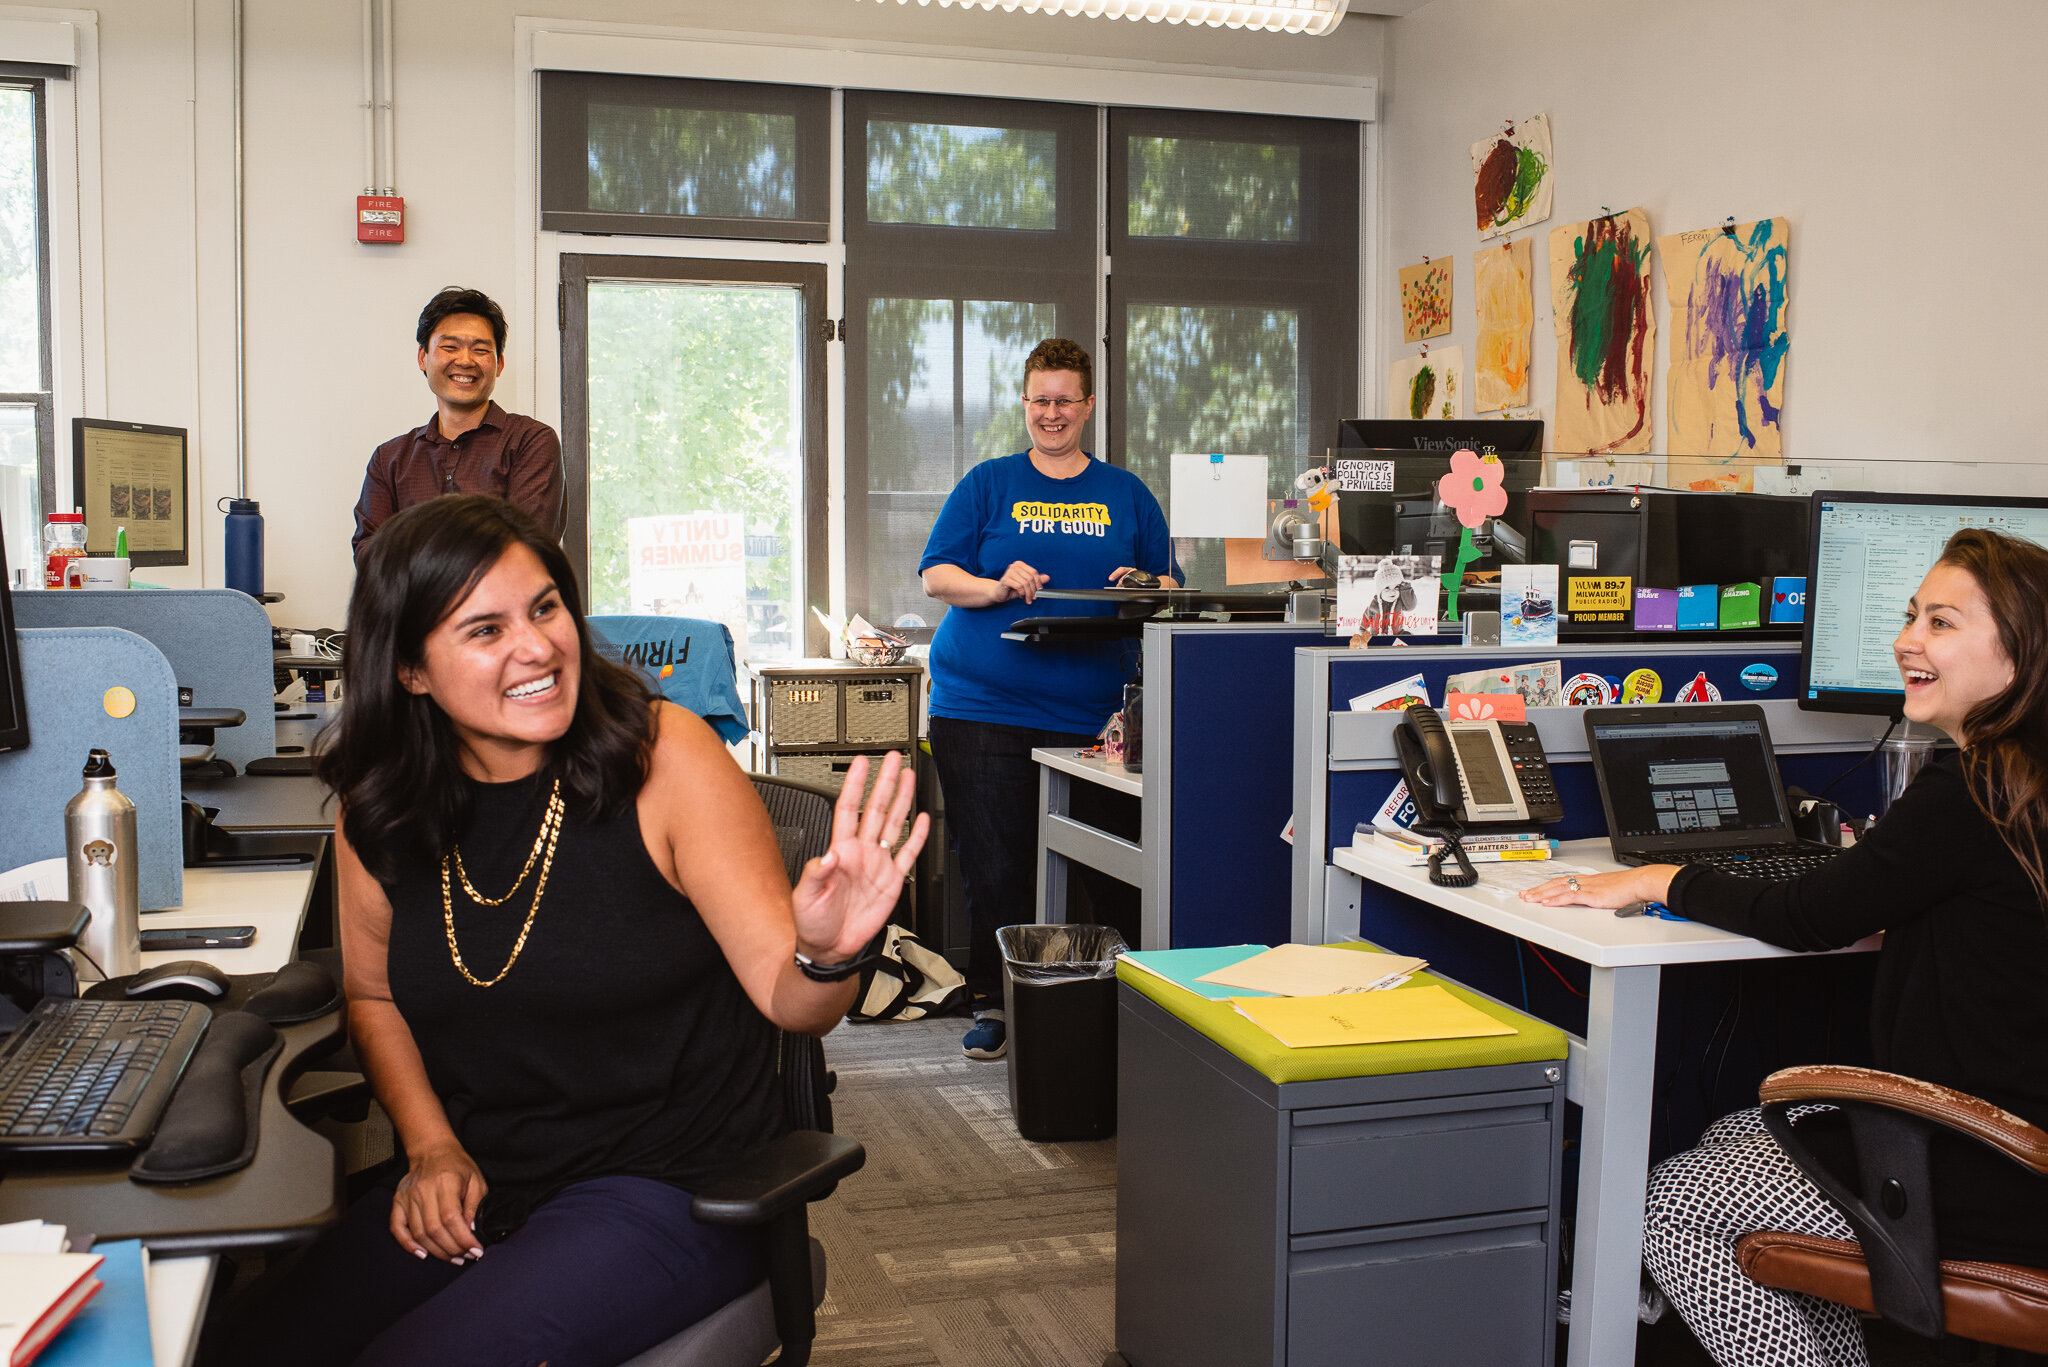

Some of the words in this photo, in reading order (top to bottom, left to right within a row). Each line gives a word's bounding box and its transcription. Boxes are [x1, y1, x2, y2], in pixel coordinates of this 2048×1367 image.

[368, 200, 392, 208] FIRE
[368, 229, 393, 237] FIRE
[1413, 436, 1481, 451] ViewSonic
[1337, 461, 1389, 471] IGNORING
[1337, 471, 1380, 480] POLITICS
[1383, 472, 1392, 481] IS
[1347, 480, 1392, 490] PRIVILEGE
[1020, 505, 1104, 520] SOLIDARITY
[1019, 518, 1055, 534] FOR
[1061, 520, 1105, 537] GOOD
[1723, 590, 1750, 598] AMAZING
[1574, 613, 1597, 622] PROUD
[1598, 613, 1625, 622] MEMBER
[623, 636, 691, 668] FIRM
[1564, 679, 1581, 701] BARKING
[1384, 786, 1409, 817] REFOR
[1397, 801, 1416, 823] FO
